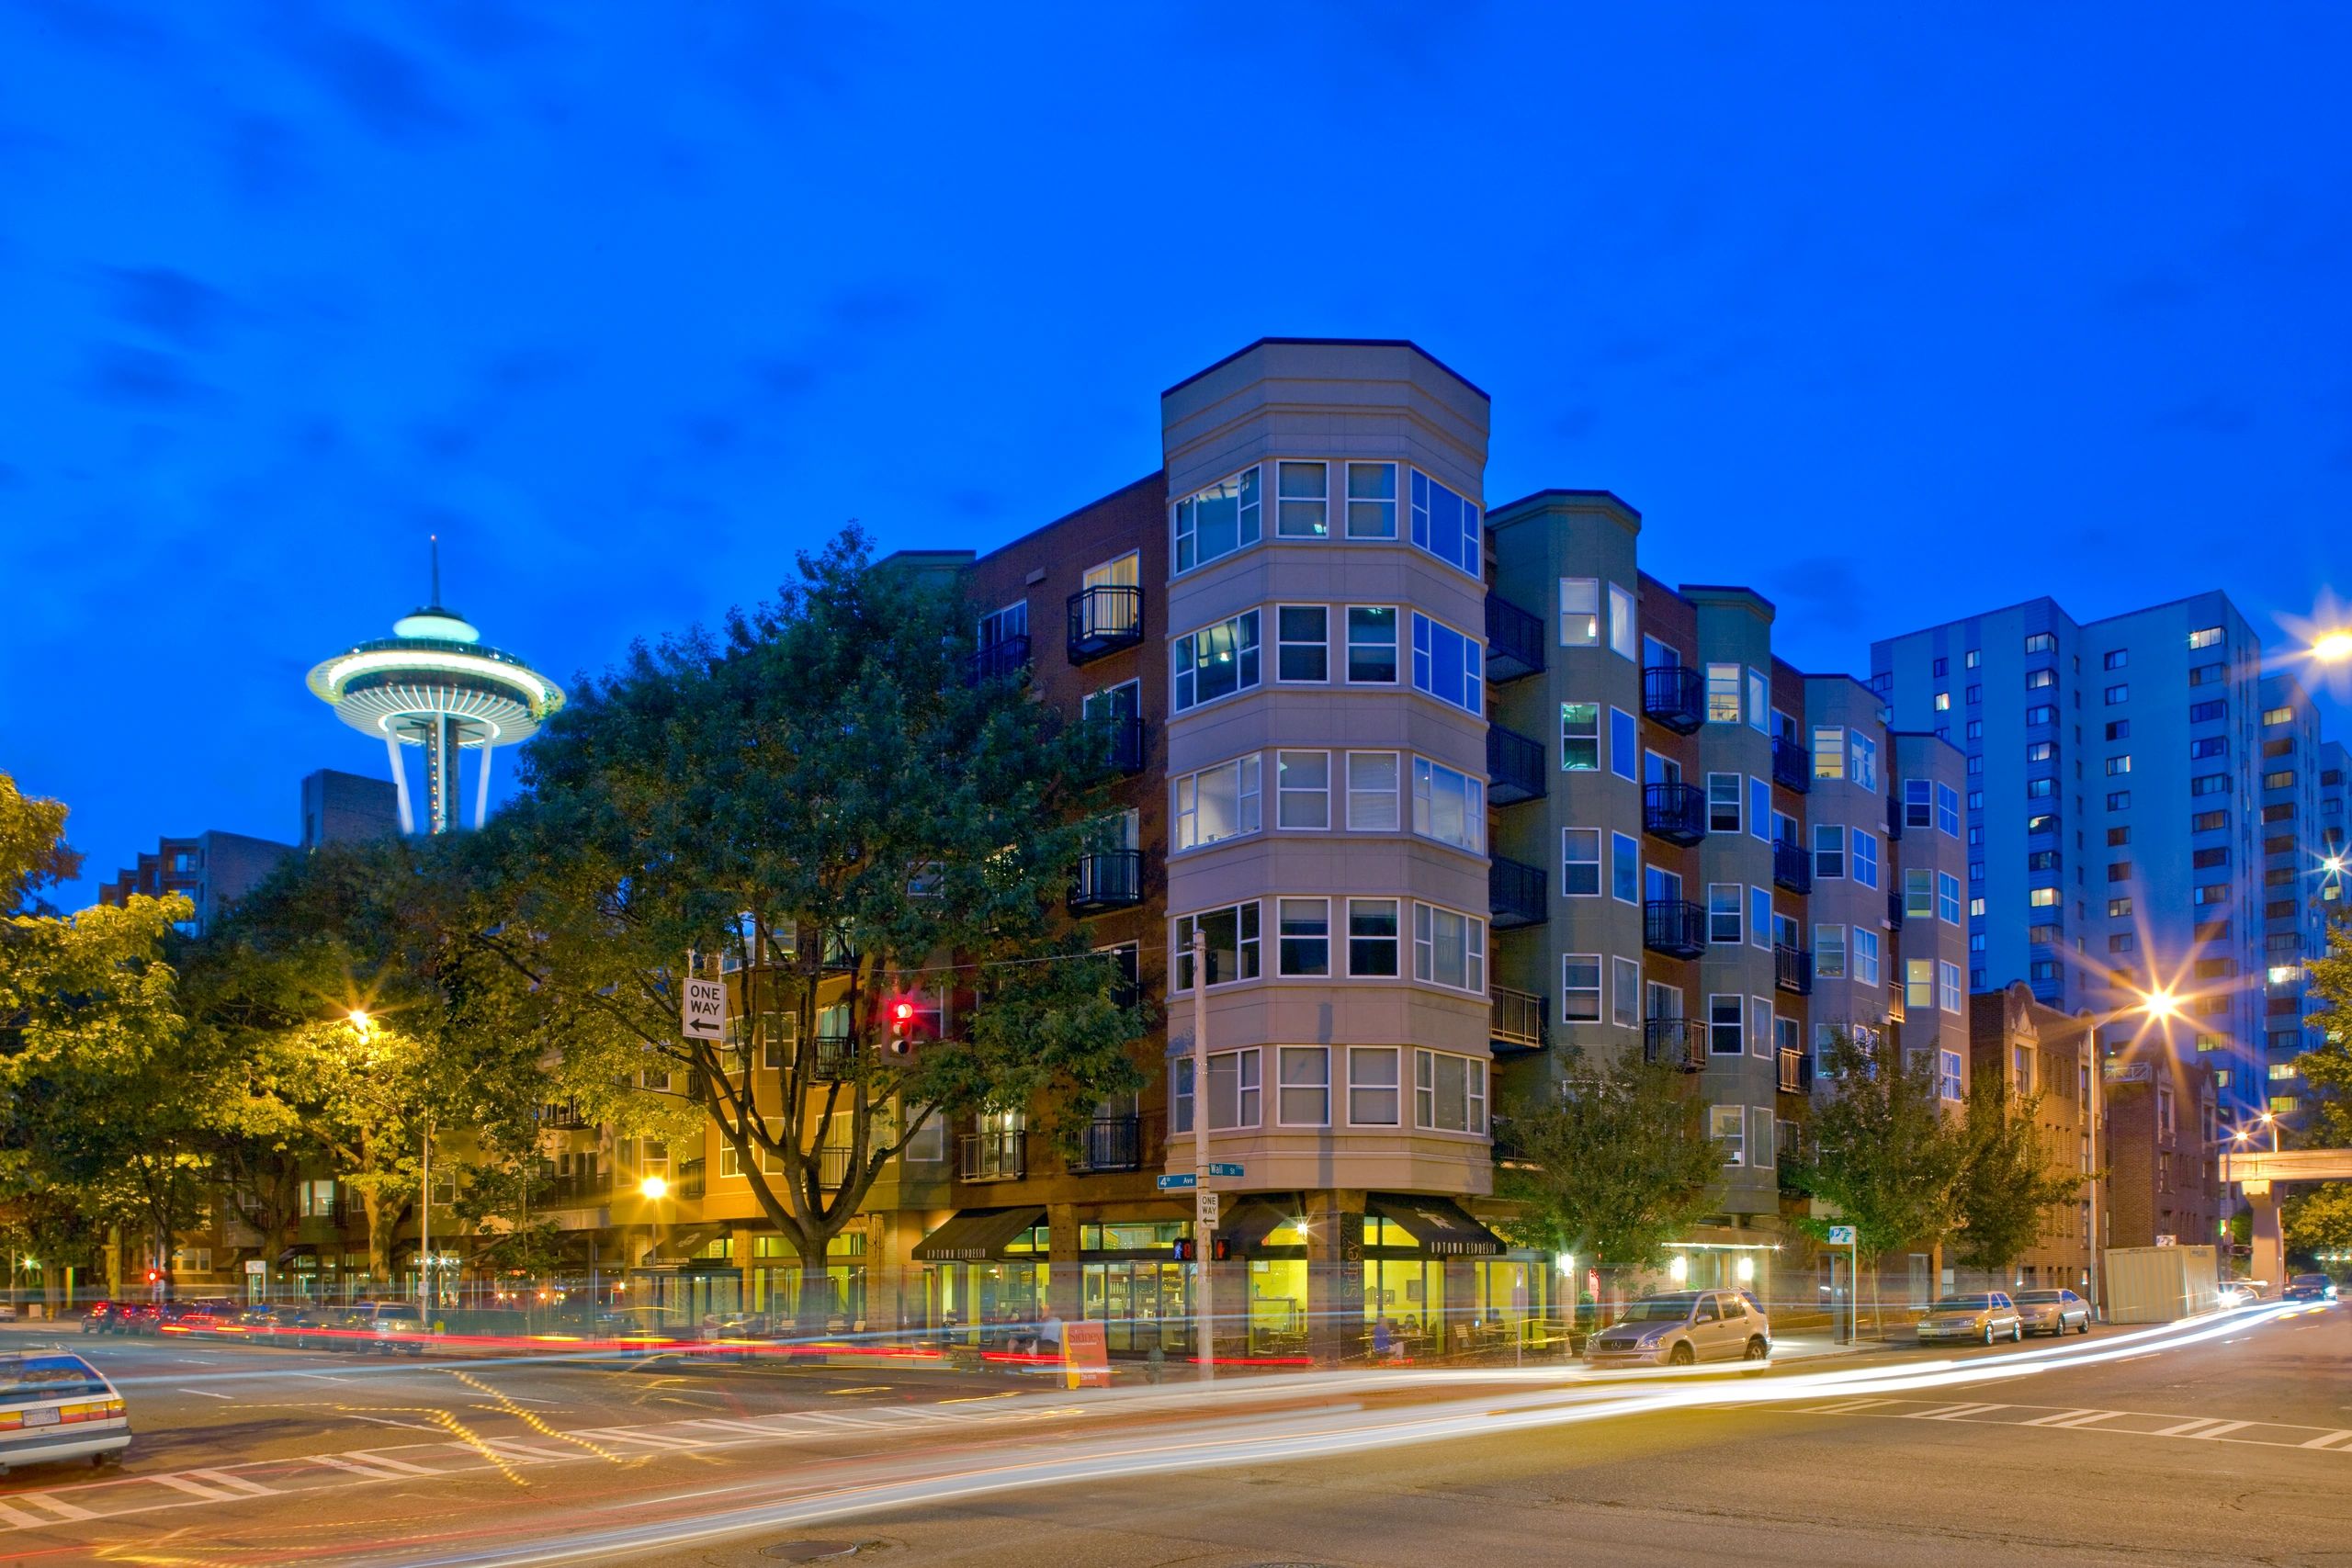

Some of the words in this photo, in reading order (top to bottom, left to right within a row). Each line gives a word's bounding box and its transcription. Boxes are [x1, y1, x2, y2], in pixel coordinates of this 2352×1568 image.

[690, 985, 720, 1000] ONE
[690, 999, 720, 1016] WAY
[1210, 1164, 1223, 1174] Wall
[1202, 1196, 1216, 1204] ONE
[1202, 1205, 1216, 1214] WAY
[957, 1248, 986, 1258] ESPRESSO
[1431, 1241, 1463, 1254] UPTOWN
[1466, 1242, 1497, 1255] ESPRESSO
[1343, 1240, 1362, 1298] Sidney
[1069, 1329, 1102, 1344] Sidney
